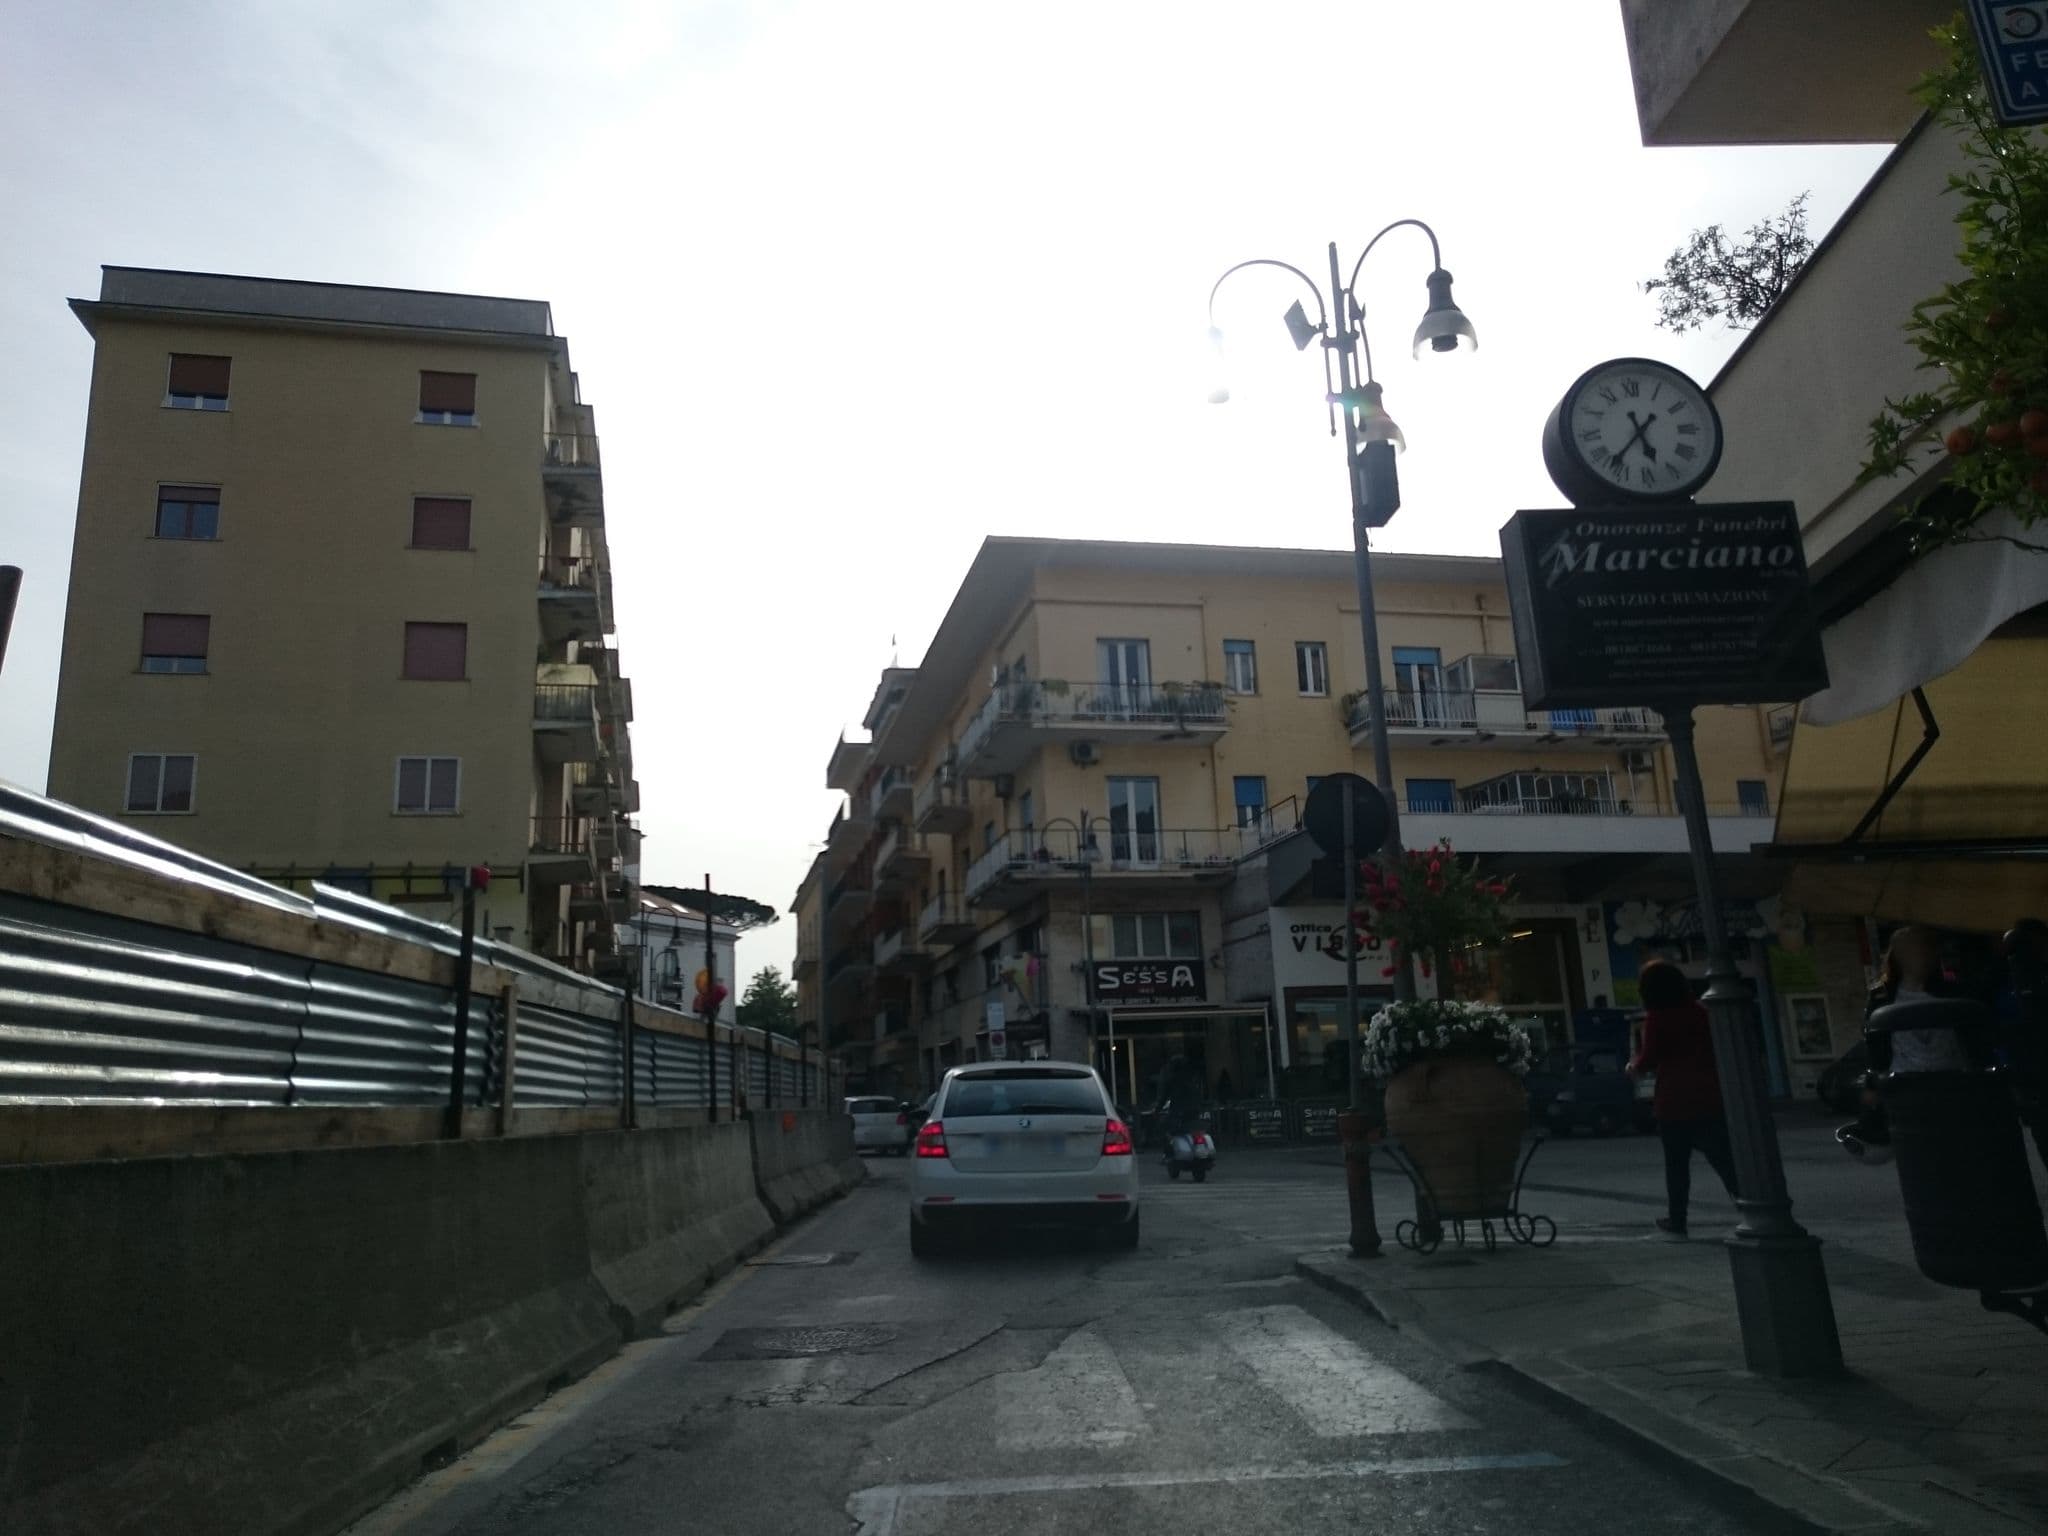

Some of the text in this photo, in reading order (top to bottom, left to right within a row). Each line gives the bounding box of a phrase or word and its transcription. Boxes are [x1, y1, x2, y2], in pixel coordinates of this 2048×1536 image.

[1575, 514, 1788, 537] Onoranze Funebri
[1556, 536, 1796, 573] Marciano
